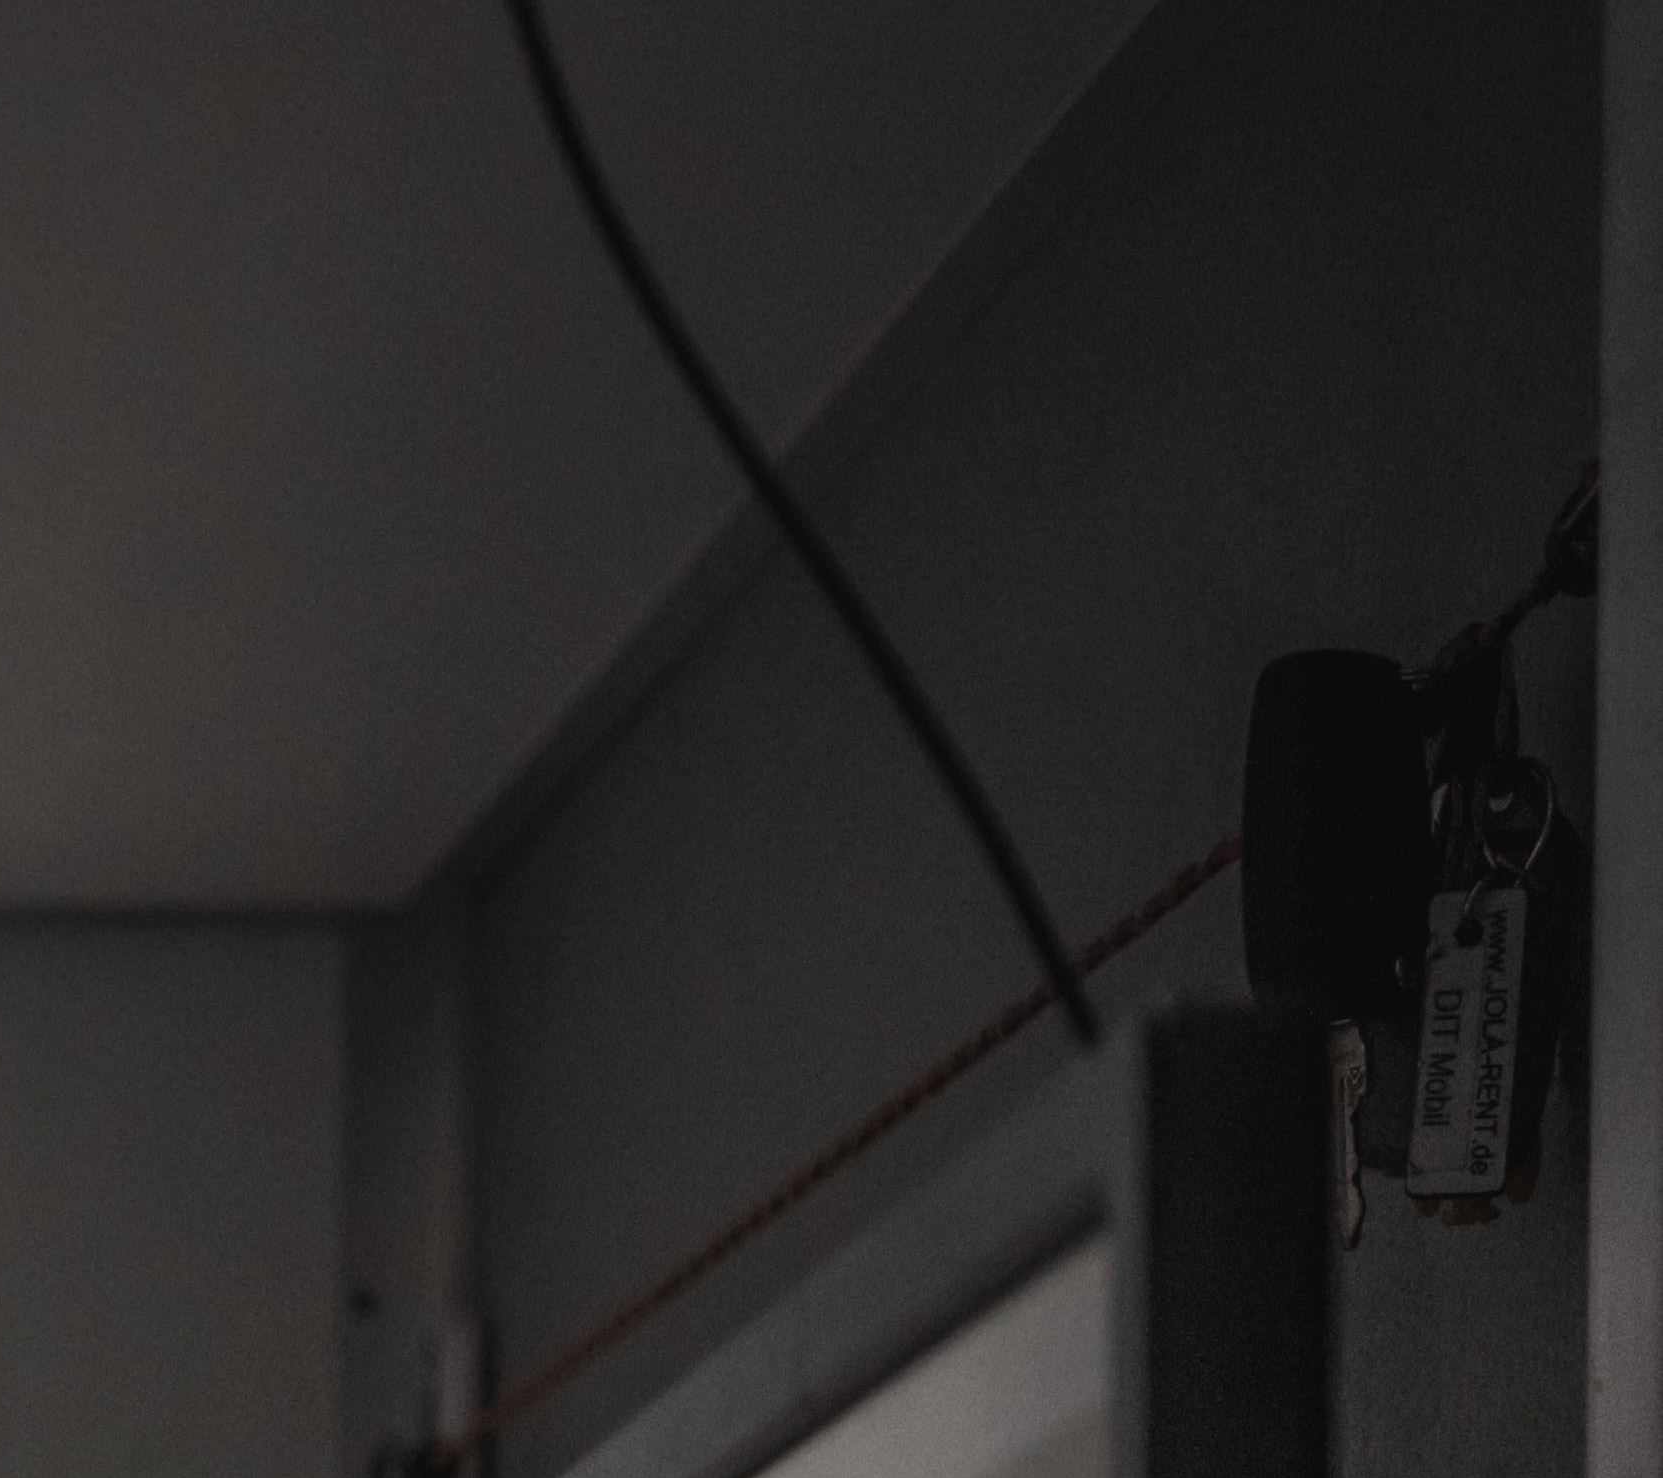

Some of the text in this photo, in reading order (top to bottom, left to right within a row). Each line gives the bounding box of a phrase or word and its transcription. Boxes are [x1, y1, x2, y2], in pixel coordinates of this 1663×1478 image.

[1422, 989, 1463, 1127] DIT Mobil
[1471, 909, 1508, 1176] www.JOLA-RENT.de
